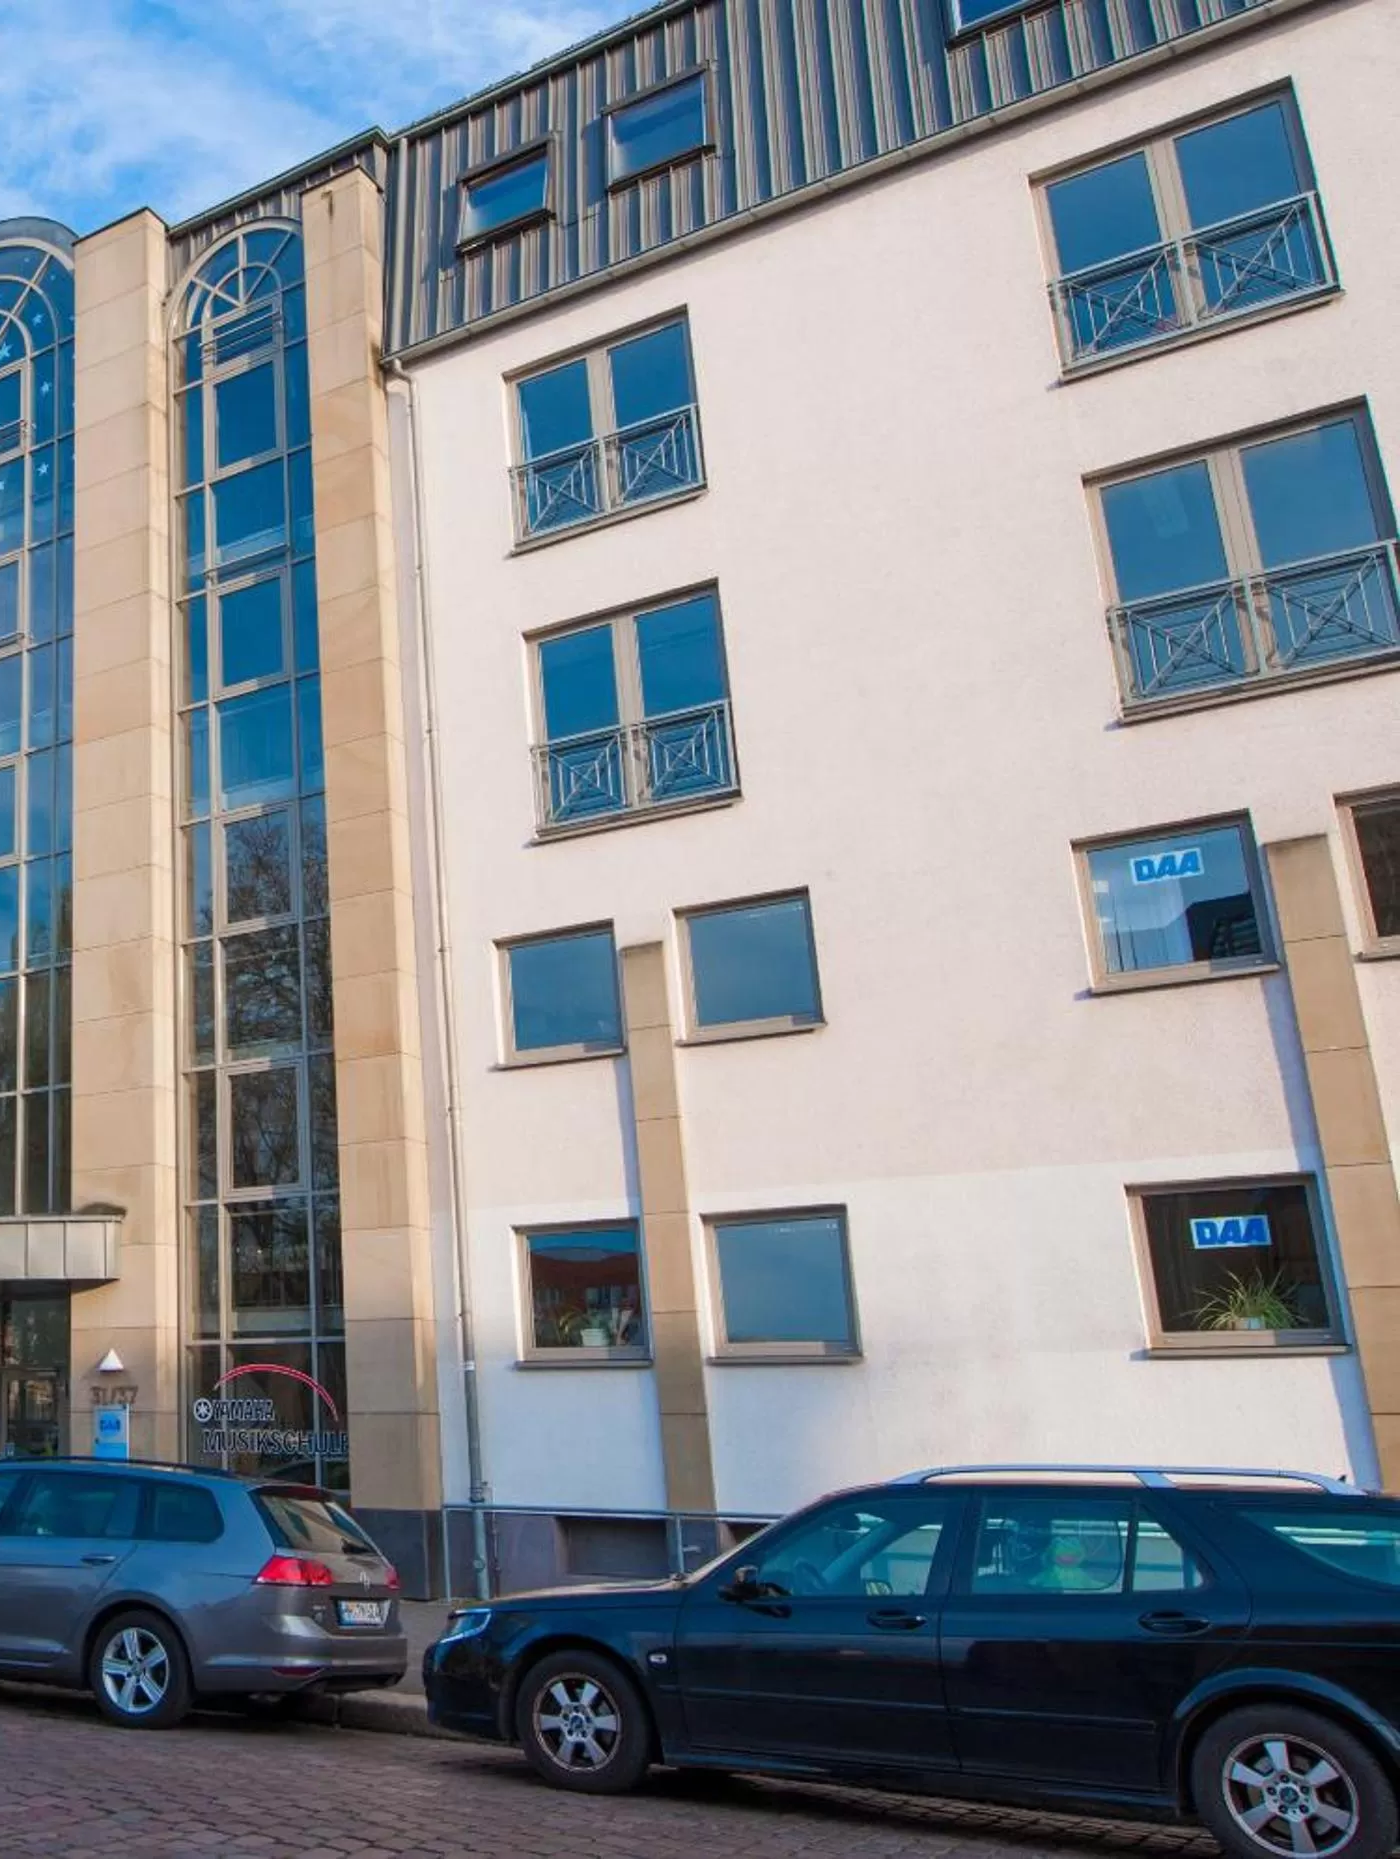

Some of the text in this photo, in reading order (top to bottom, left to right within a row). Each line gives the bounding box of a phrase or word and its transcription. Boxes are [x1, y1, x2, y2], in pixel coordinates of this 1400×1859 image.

[1135, 850, 1200, 881] DAA
[1195, 1218, 1267, 1245] DAA
[212, 1398, 276, 1421] YAMAHA
